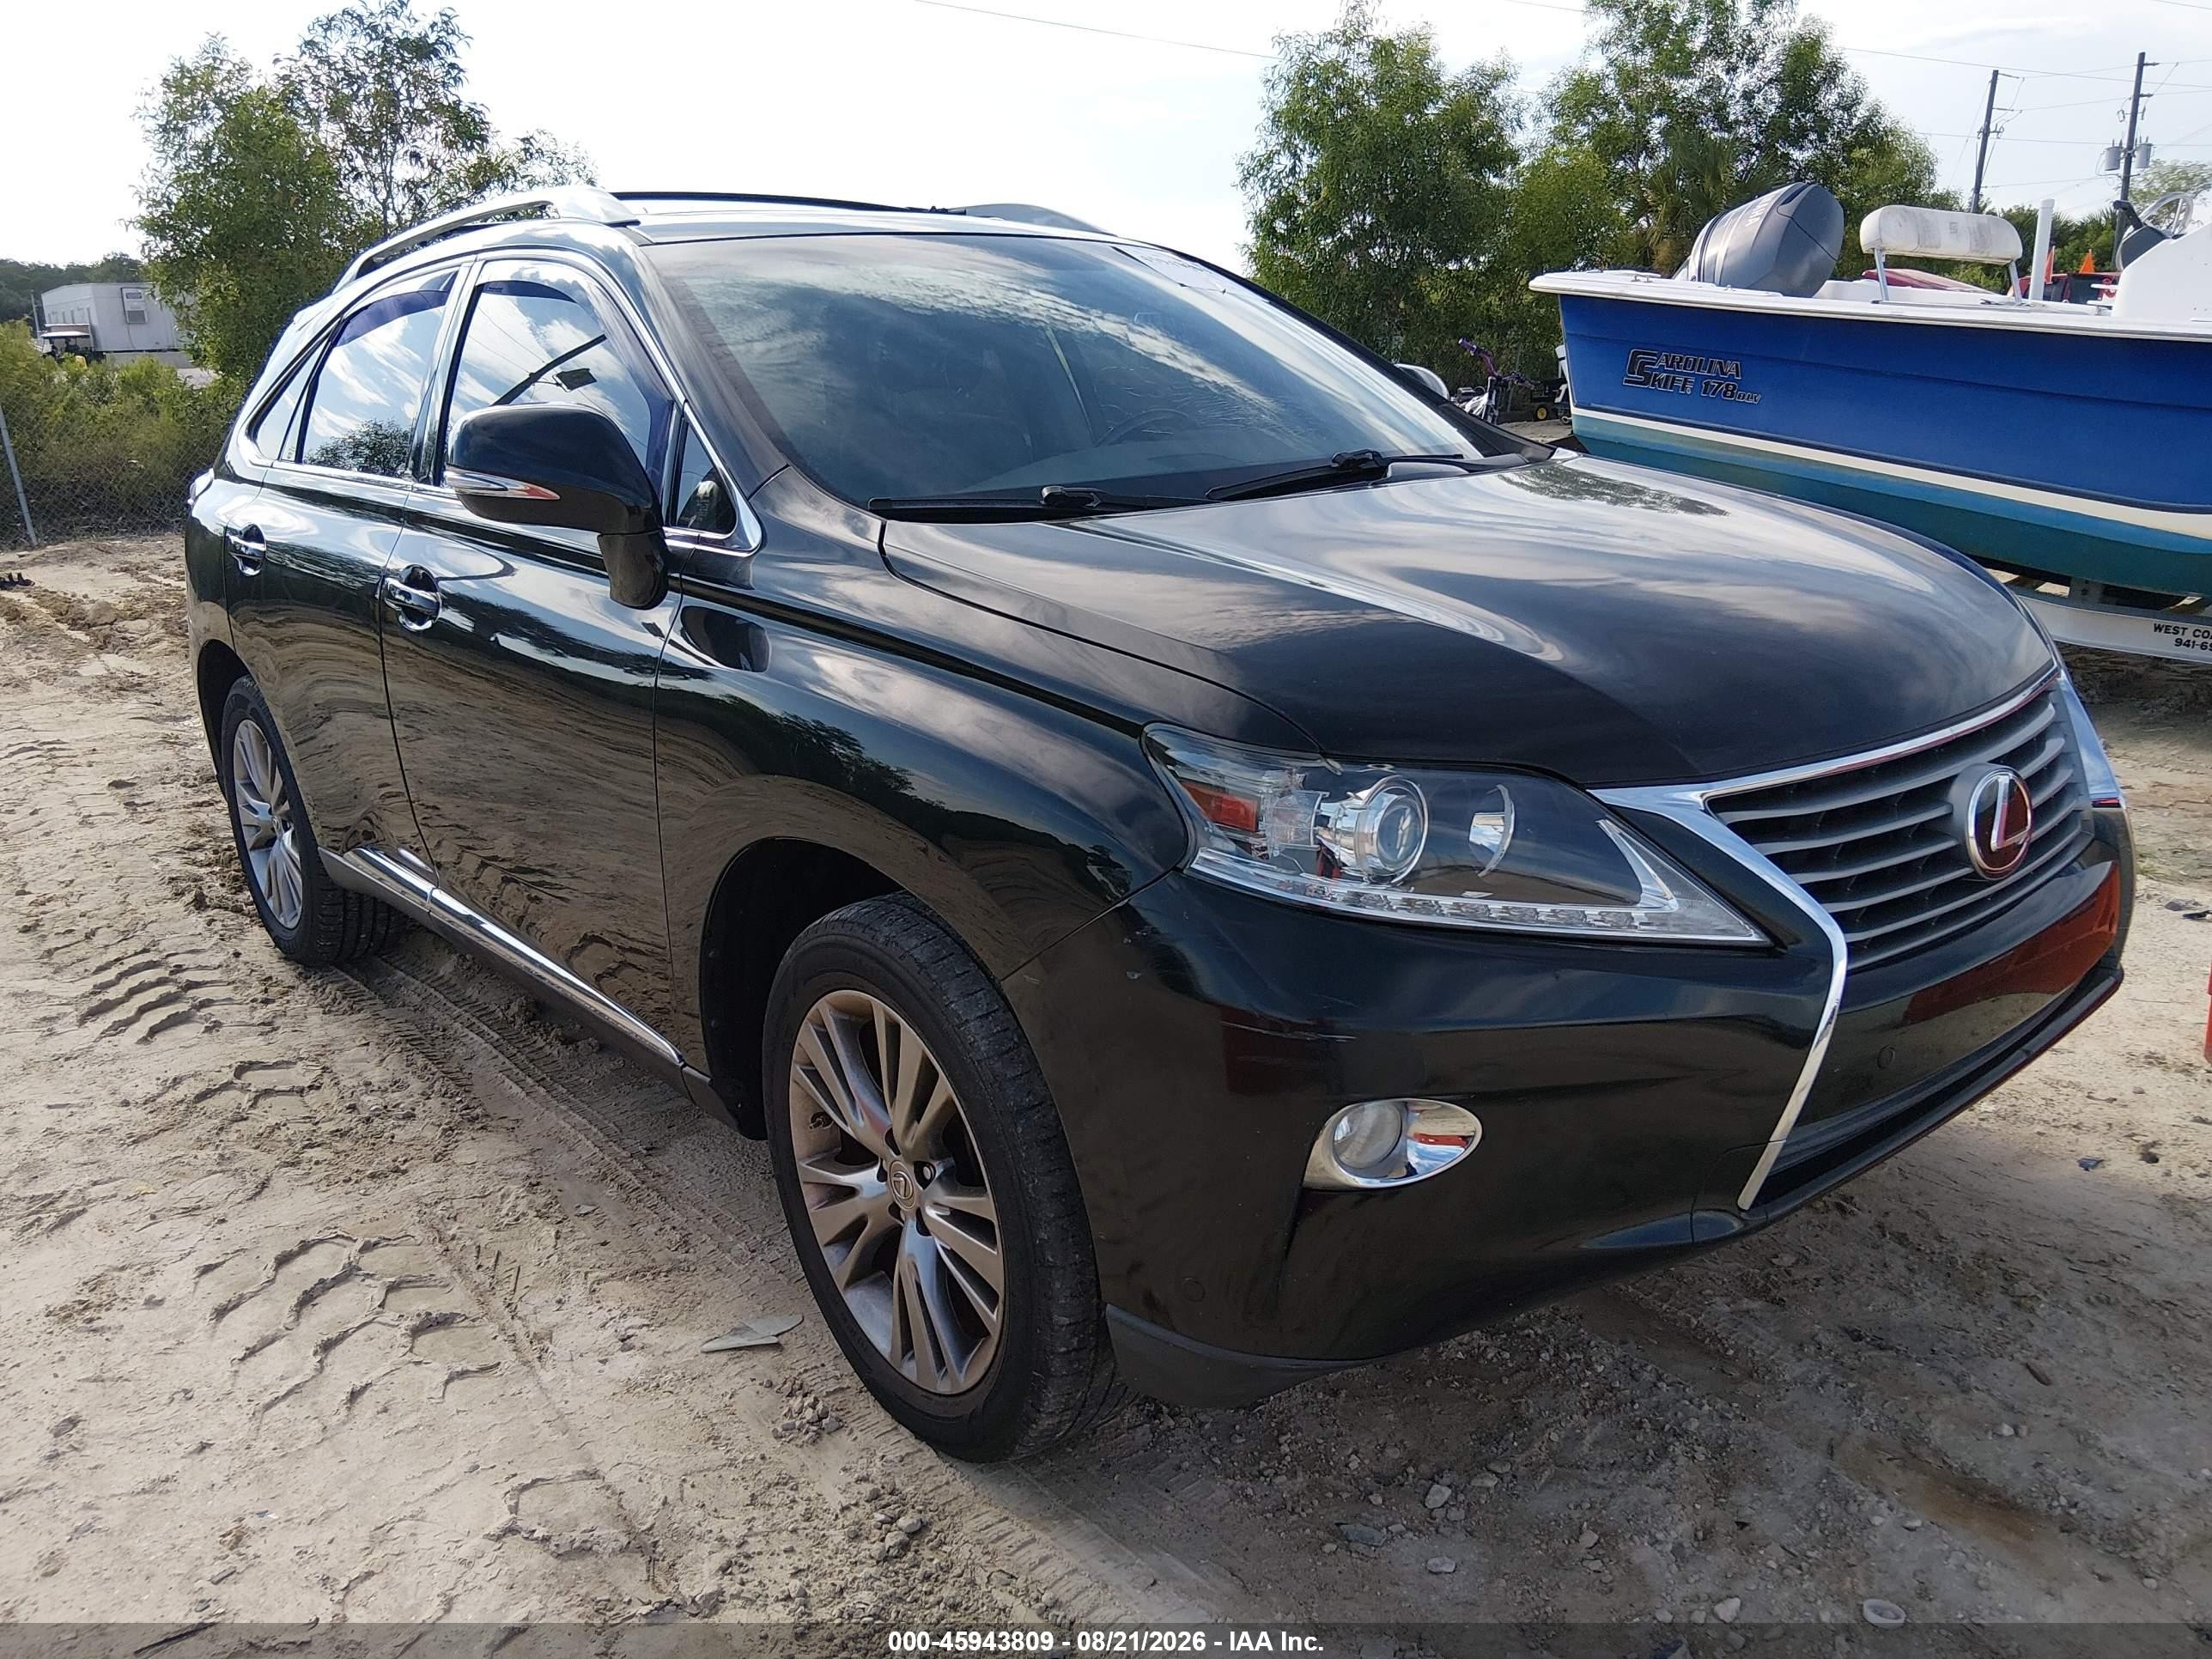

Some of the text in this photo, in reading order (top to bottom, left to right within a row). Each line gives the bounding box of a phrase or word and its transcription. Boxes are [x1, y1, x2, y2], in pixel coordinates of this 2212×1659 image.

[1626, 349, 1742, 380] CAROLINA
[2154, 623, 2212, 641] WEST CO
